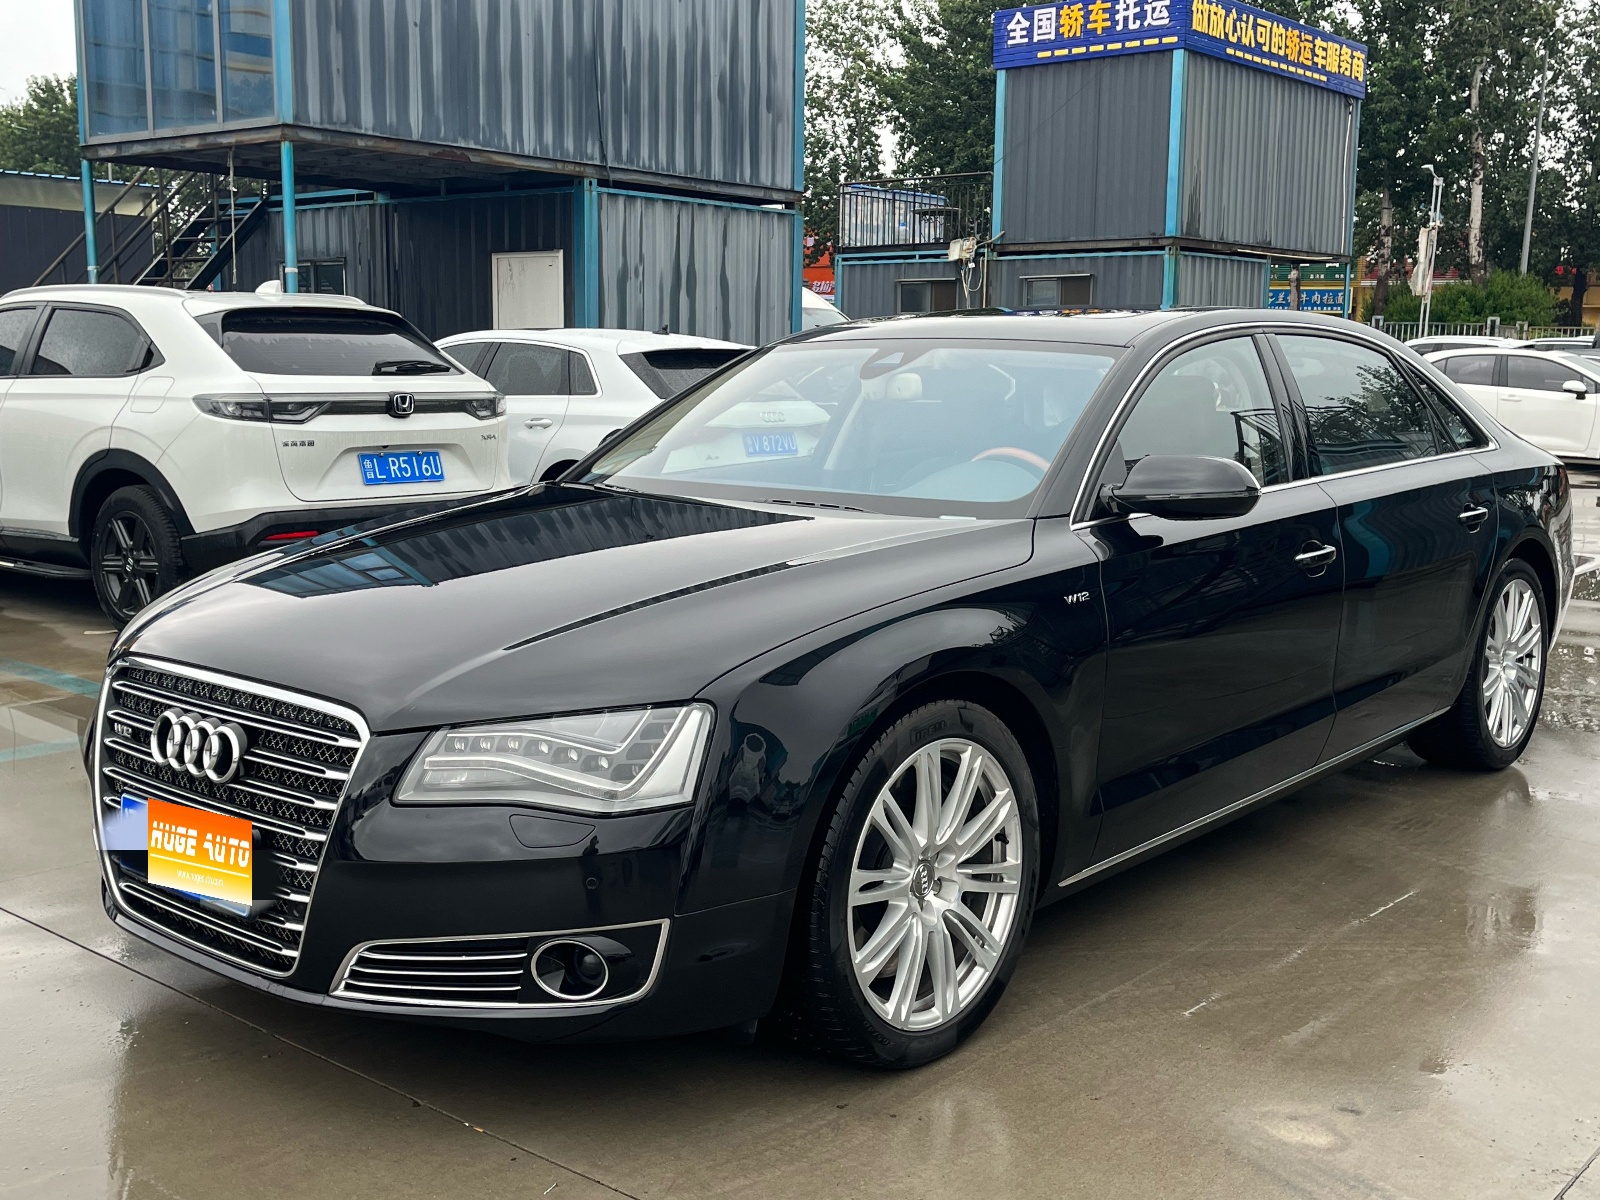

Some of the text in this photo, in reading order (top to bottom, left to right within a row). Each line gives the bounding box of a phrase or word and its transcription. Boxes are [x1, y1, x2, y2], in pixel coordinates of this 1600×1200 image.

[1006, 0, 1171, 46] 全国轿车托运
[1191, 0, 1366, 83] 做放心认可的轿运车服务商
[1275, 291, 1344, 305] 兰牛肉拉面
[1063, 591, 1090, 604] W12
